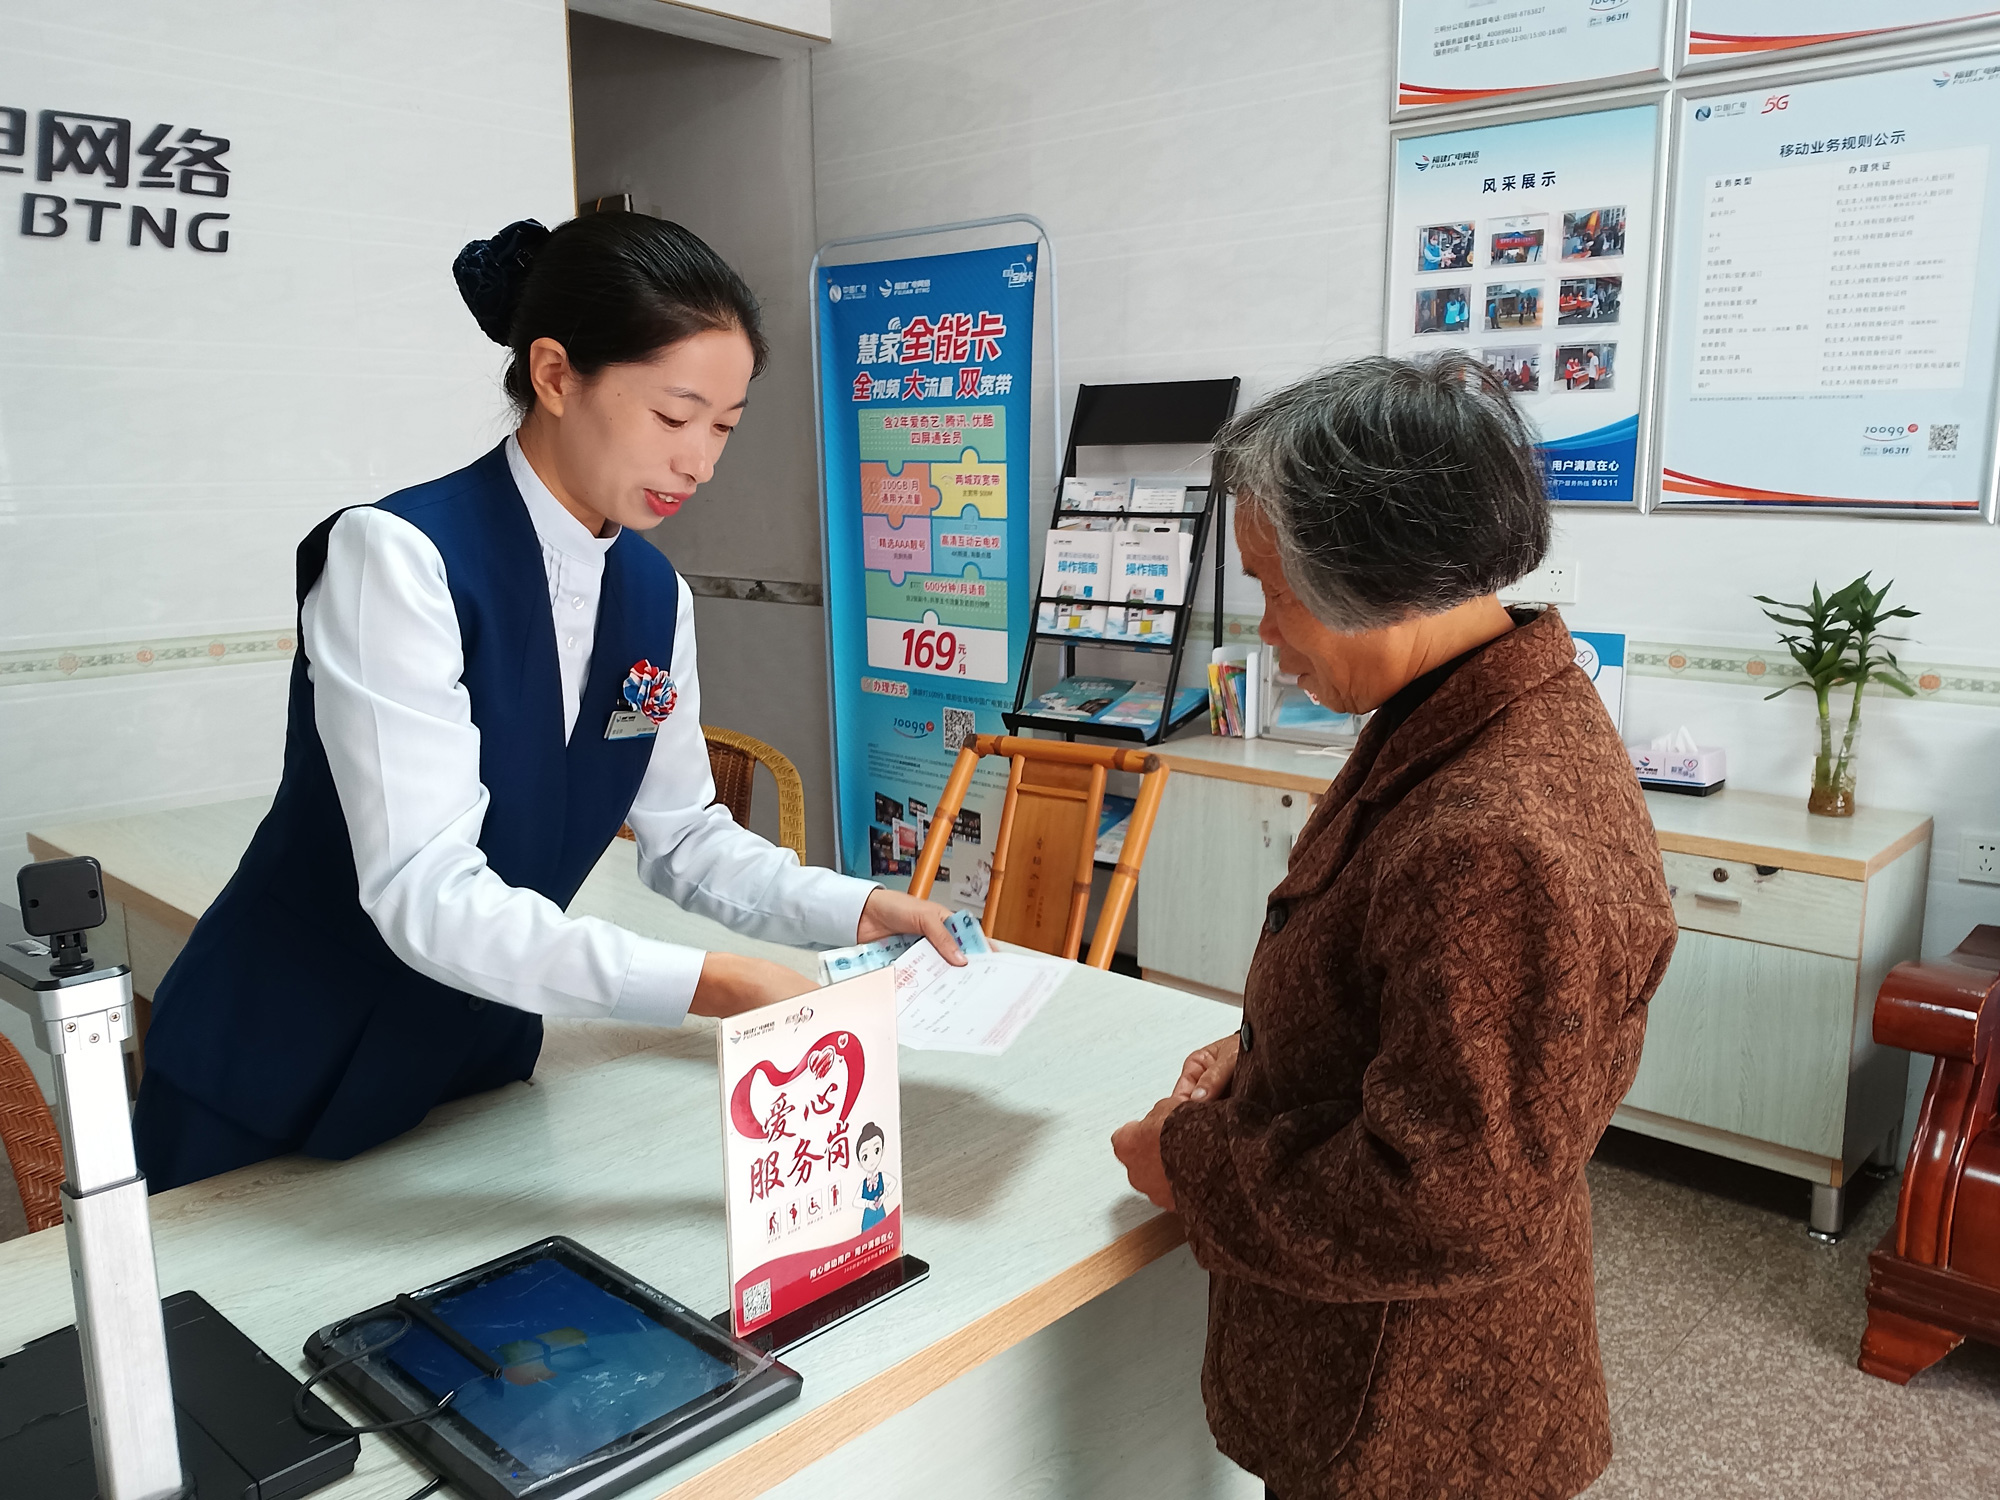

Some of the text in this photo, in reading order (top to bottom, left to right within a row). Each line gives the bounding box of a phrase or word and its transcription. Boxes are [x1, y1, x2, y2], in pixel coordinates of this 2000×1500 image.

[1606, 12, 1629, 22] 96311
[1714, 101, 1747, 112] 中国广电
[1760, 93, 1791, 115] 5G
[1779, 129, 1906, 158] 移动业务规则公示
[1432, 150, 1480, 163] 福建广电网络
[1431, 161, 1457, 169] FUJIAN
[1848, 160, 1891, 175] 办理凭证
[1482, 171, 1557, 194] 风采展示
[1714, 177, 1753, 189] 业务类型
[21, 193, 231, 253] BTNG
[852, 367, 1013, 402] 全视频 大流量 双宽带
[883, 414, 994, 429] 含2年爱奇艺、腾讯、优酷
[910, 431, 962, 445] 四屏通会员
[1865, 426, 1905, 436] 10099
[1882, 446, 1910, 455] 96311
[1552, 460, 1620, 472] 用户满意在心
[1591, 479, 1618, 487] 96311
[881, 493, 922, 505] 通用大流量
[941, 534, 1001, 549] 高清互动云电视
[1057, 560, 1098, 575] 操作指南
[1125, 563, 1168, 577] 操作指南
[924, 581, 986, 596] 600分钟/月语音
[902, 628, 957, 672] 169
[872, 680, 908, 697] 办理方式
[893, 717, 926, 734] 10099
[763, 1083, 838, 1143] 爱心
[749, 1121, 850, 1204] 服务岗
[809, 1231, 894, 1280] 用心感动用户 用户满意在心
